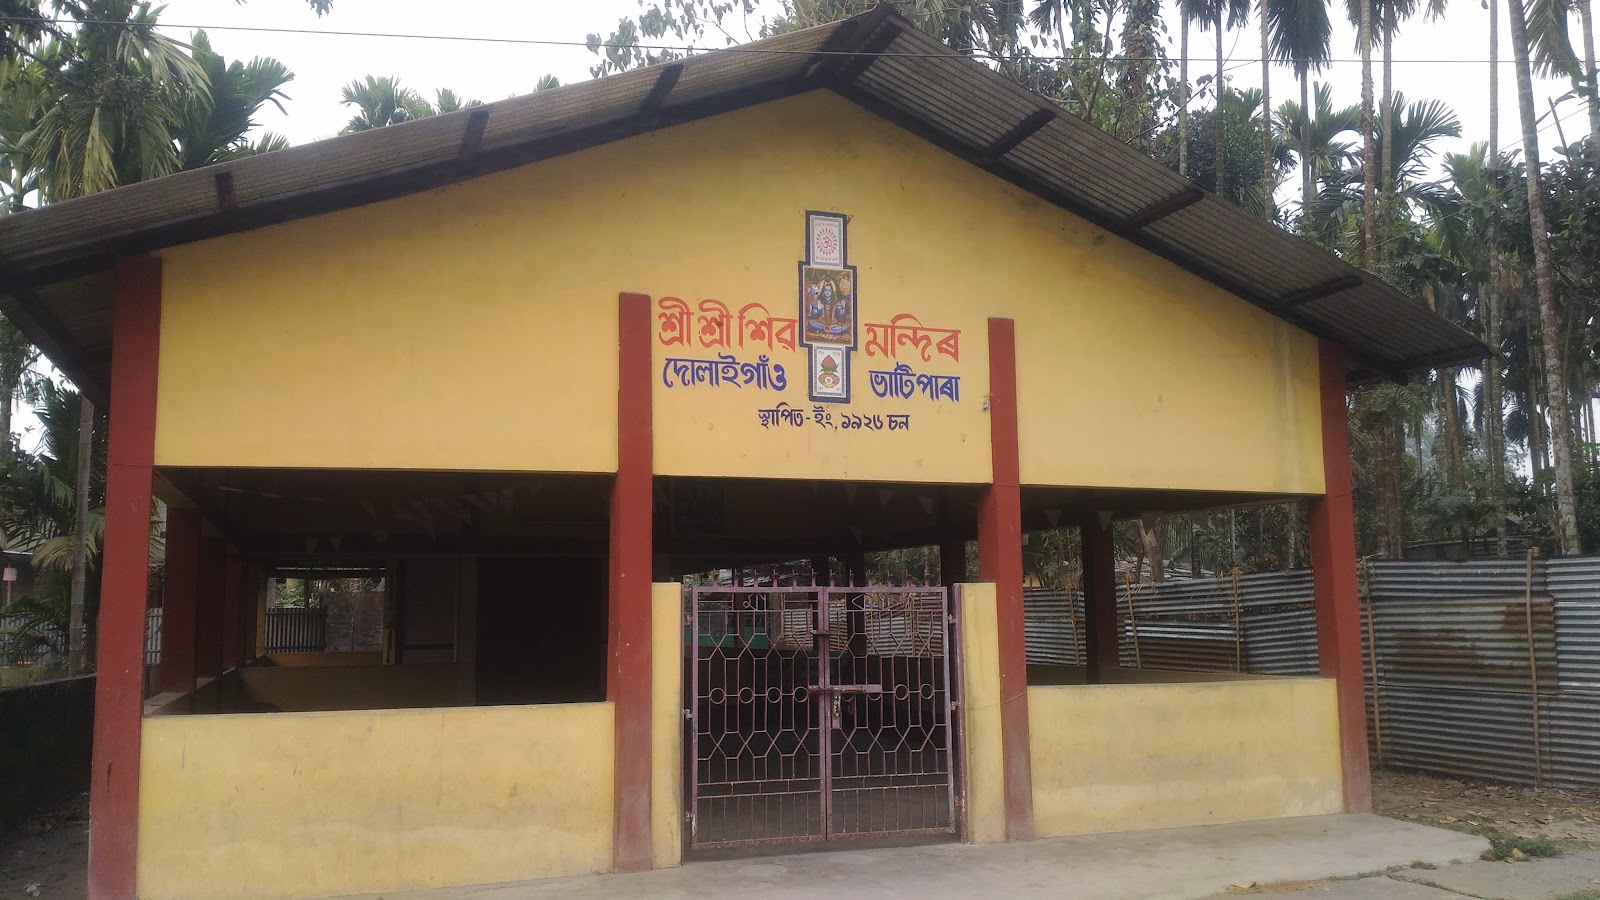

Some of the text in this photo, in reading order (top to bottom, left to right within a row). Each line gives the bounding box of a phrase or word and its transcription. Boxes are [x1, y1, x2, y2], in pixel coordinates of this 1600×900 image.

[864, 313, 961, 363] মন্দিৰ
[663, 352, 960, 403] দোলাইগাঁও ভাটিপাৰা
